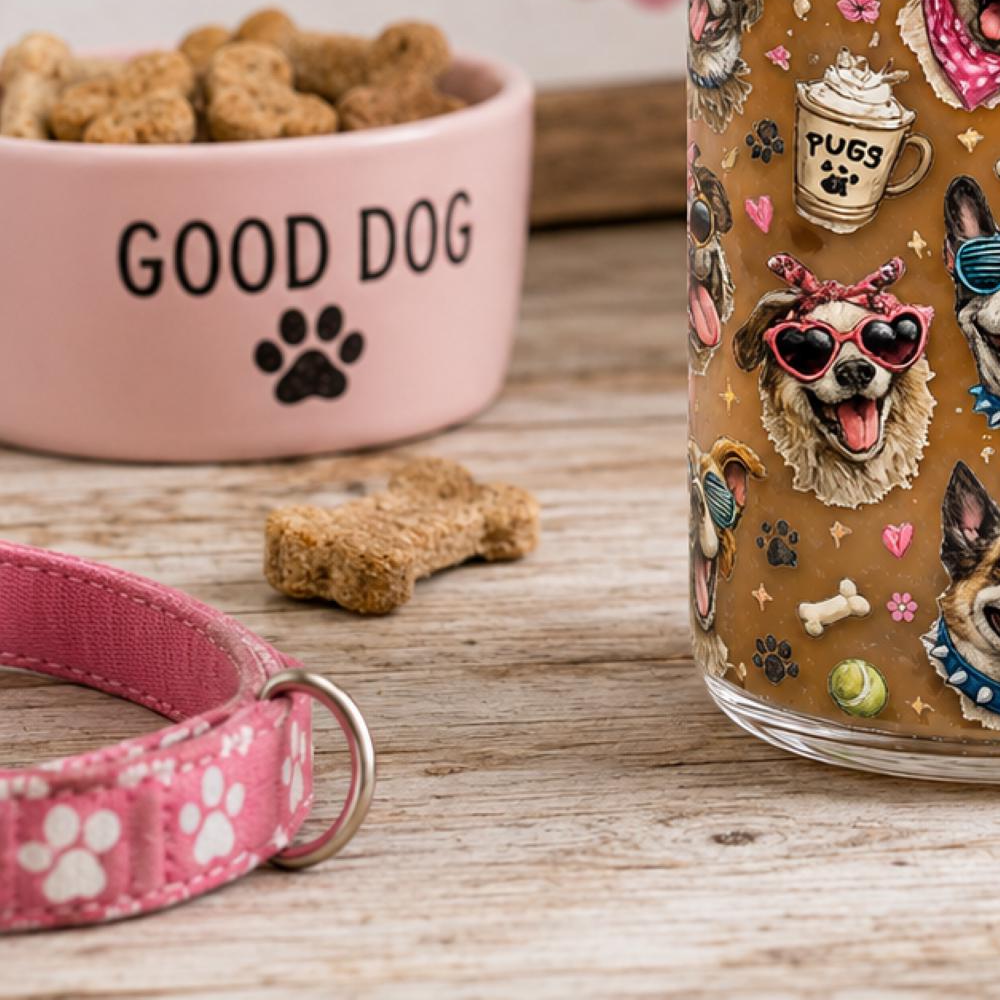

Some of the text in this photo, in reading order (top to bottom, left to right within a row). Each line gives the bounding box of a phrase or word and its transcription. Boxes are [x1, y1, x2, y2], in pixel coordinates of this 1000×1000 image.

[806, 132, 884, 169] PUGS
[117, 190, 473, 298] GOOD DOG
